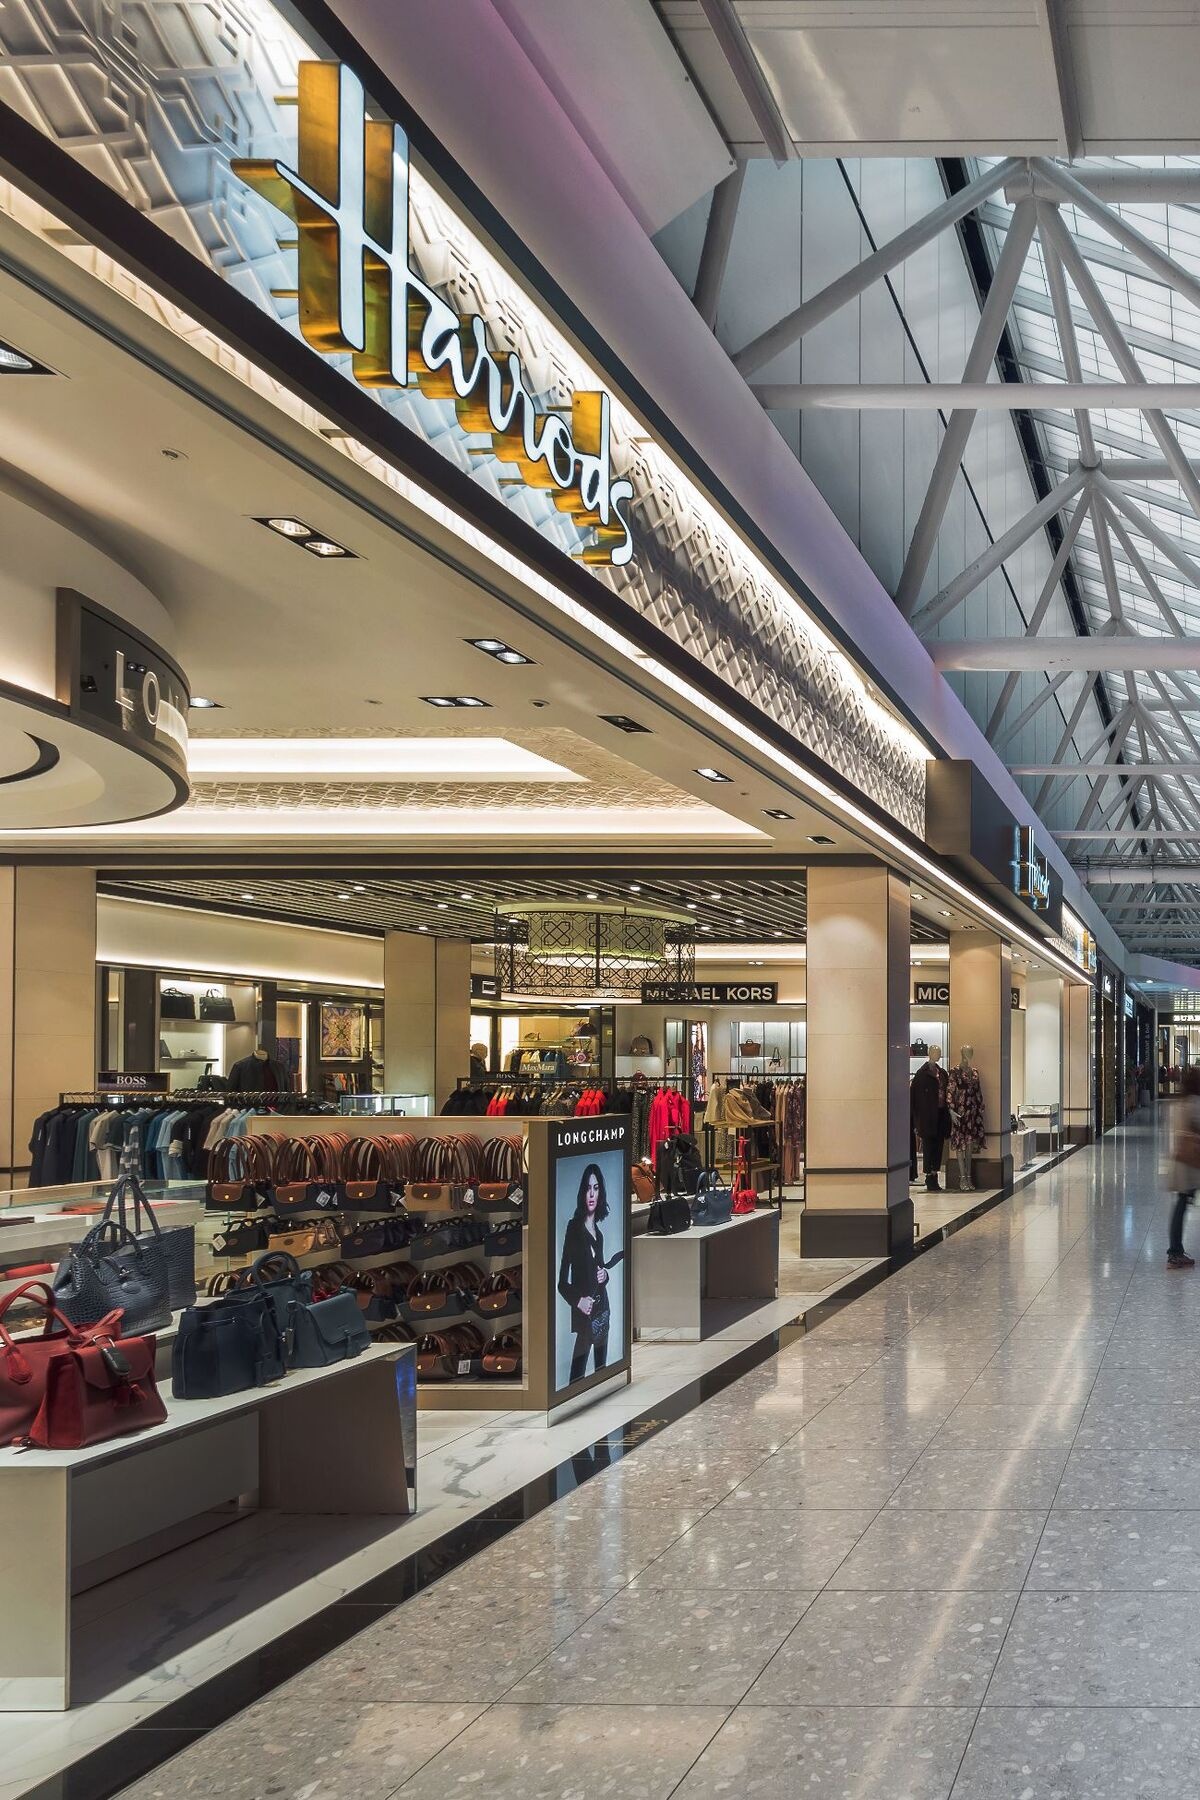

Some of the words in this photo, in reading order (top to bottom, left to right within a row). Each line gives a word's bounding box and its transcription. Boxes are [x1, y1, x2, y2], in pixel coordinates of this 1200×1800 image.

[270, 60, 636, 568] Harrods
[646, 987, 720, 1001] MICHAEL
[727, 987, 773, 1001] KORS
[116, 1075, 147, 1085] BOSS
[557, 1127, 625, 1146] LONGCHAMP
